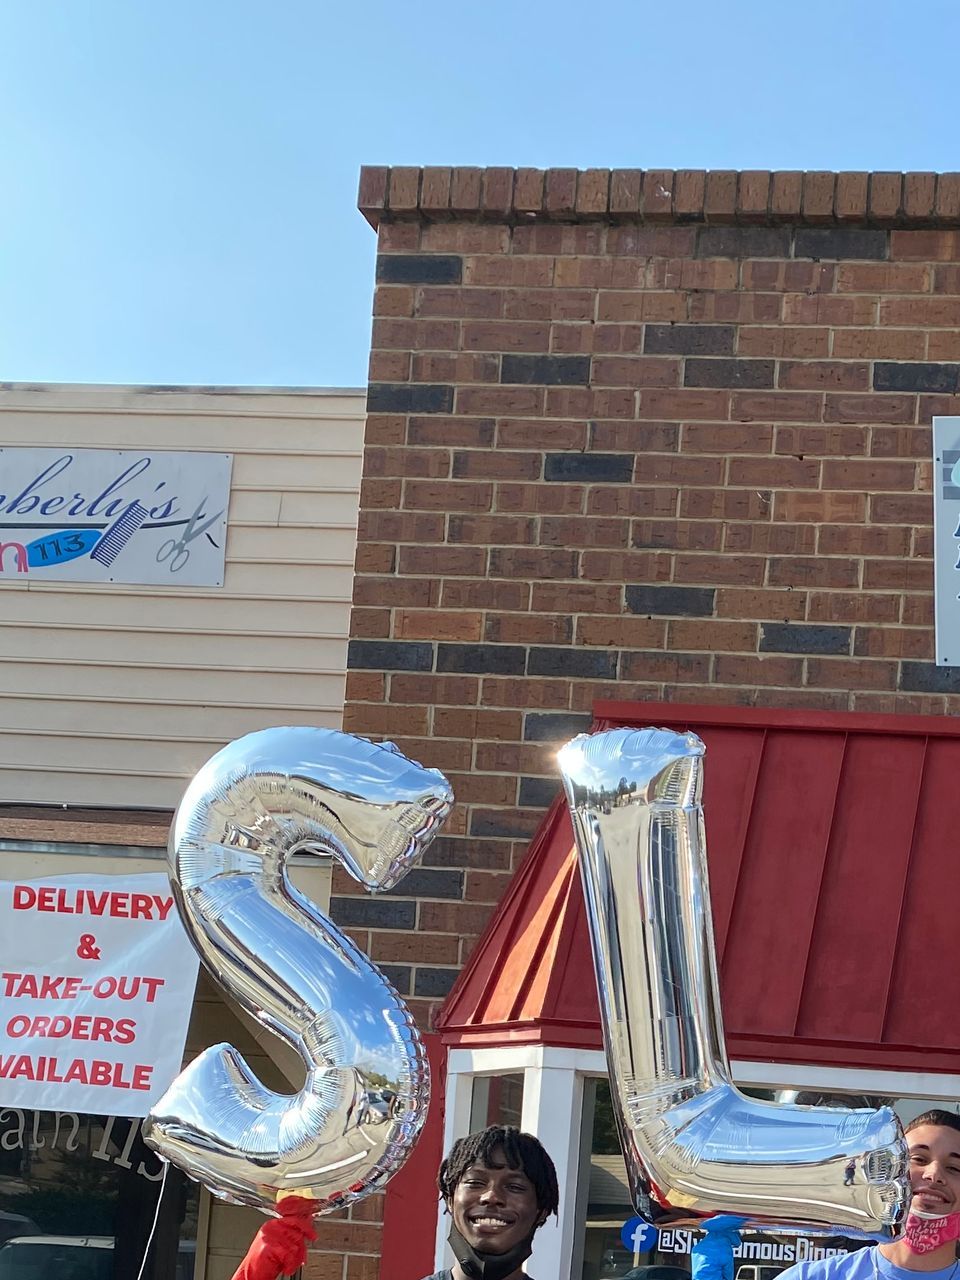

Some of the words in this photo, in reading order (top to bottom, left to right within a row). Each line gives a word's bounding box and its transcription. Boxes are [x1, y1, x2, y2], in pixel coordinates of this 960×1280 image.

[0, 455, 182, 519] berly's
[33, 533, 88, 561] 113
[13, 886, 175, 921] DELIVERY
[76, 934, 102, 960] &
[2, 973, 165, 1003] TAKE-OUT
[6, 1015, 137, 1044] ORDERS
